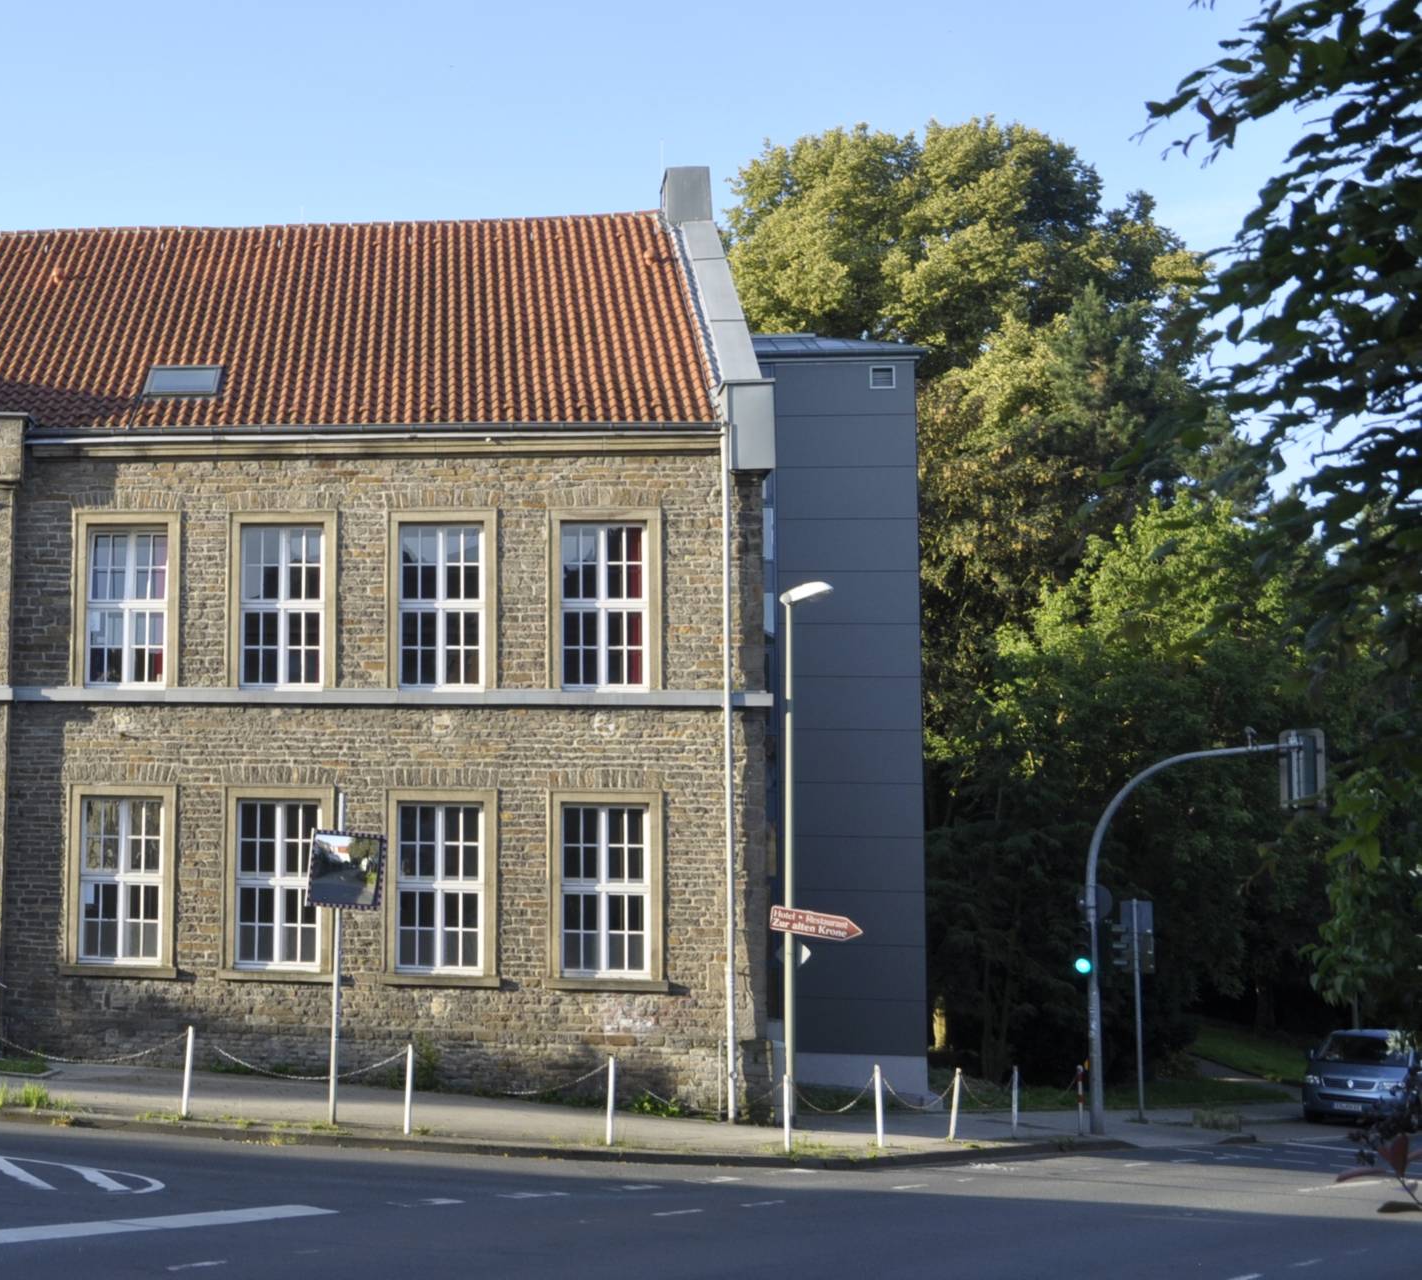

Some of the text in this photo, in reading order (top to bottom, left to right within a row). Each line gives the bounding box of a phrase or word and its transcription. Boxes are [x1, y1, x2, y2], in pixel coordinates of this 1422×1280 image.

[772, 918, 848, 938] Zur alten Krone
[773, 909, 849, 929] Hotel Restaurant
